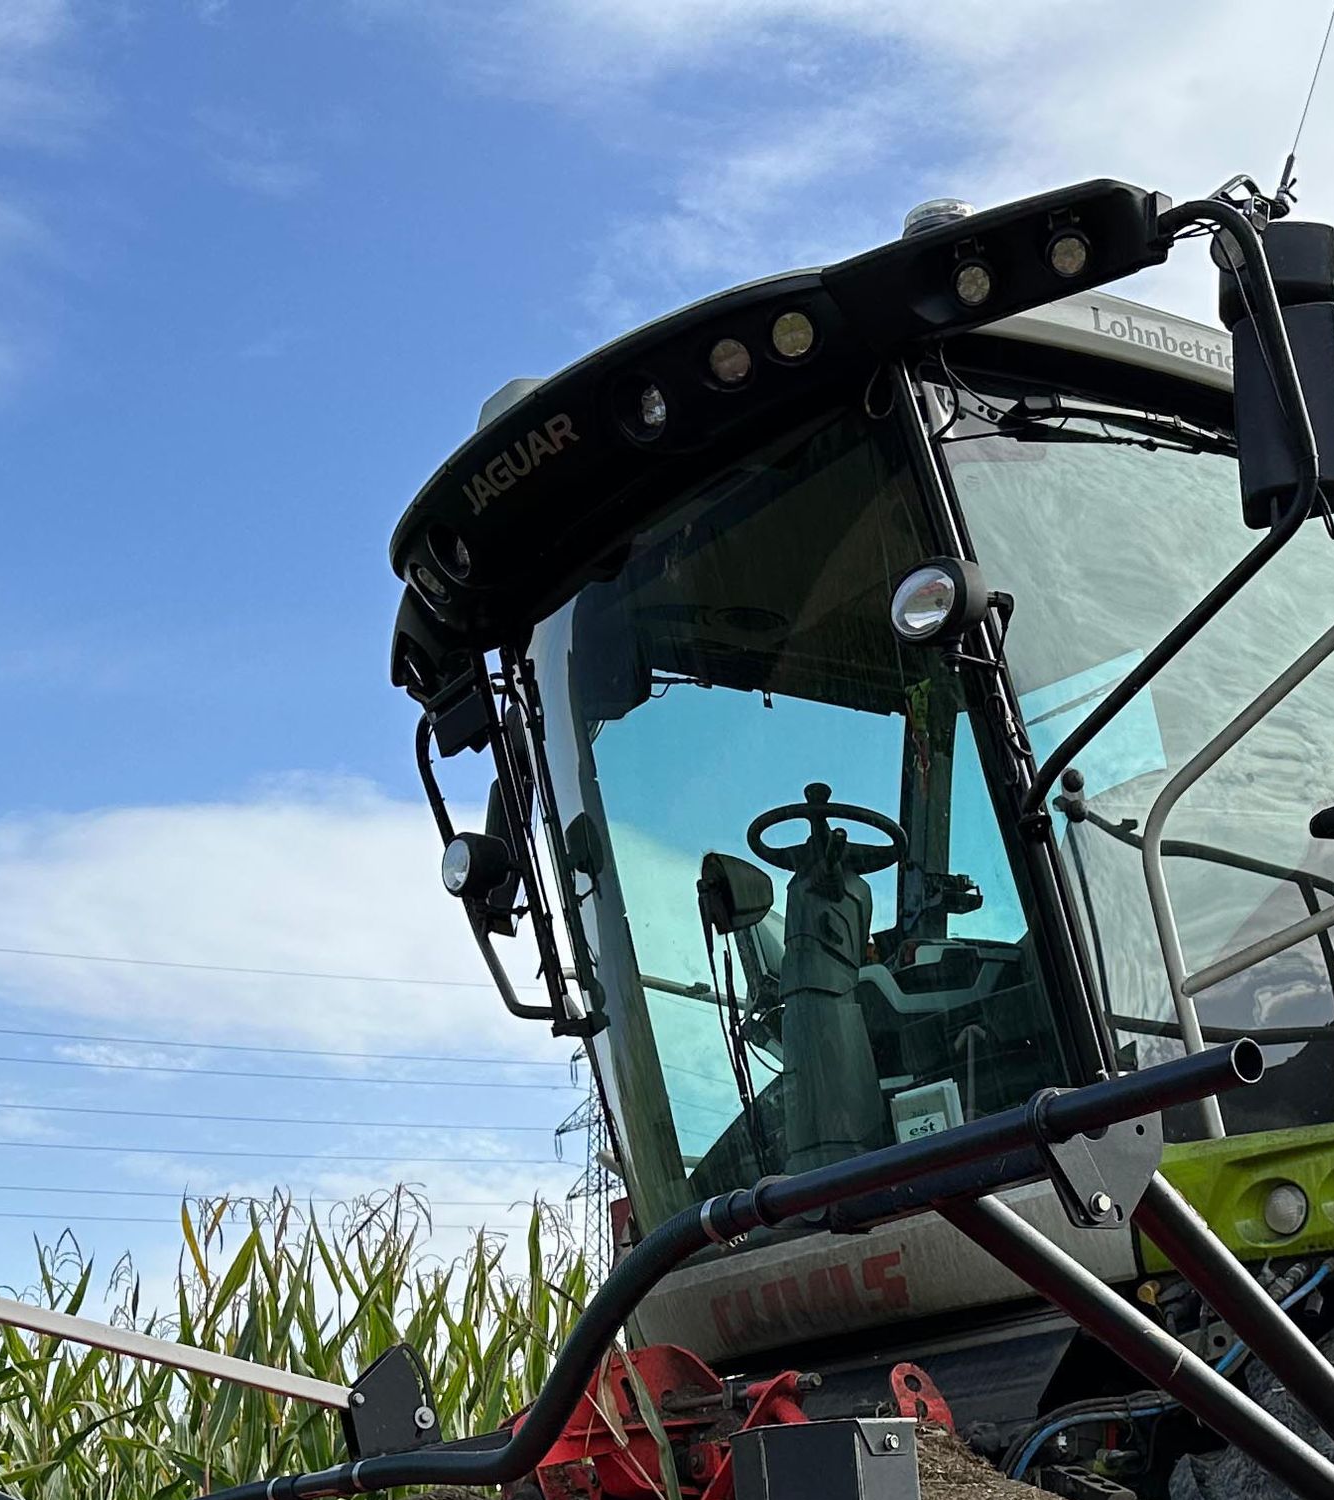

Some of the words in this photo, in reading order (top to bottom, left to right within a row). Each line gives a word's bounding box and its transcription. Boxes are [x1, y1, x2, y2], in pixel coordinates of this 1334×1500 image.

[1090, 305, 1234, 371] Lohnbetrie
[462, 413, 580, 516] JAGUAR
[909, 1121, 936, 1136] est
